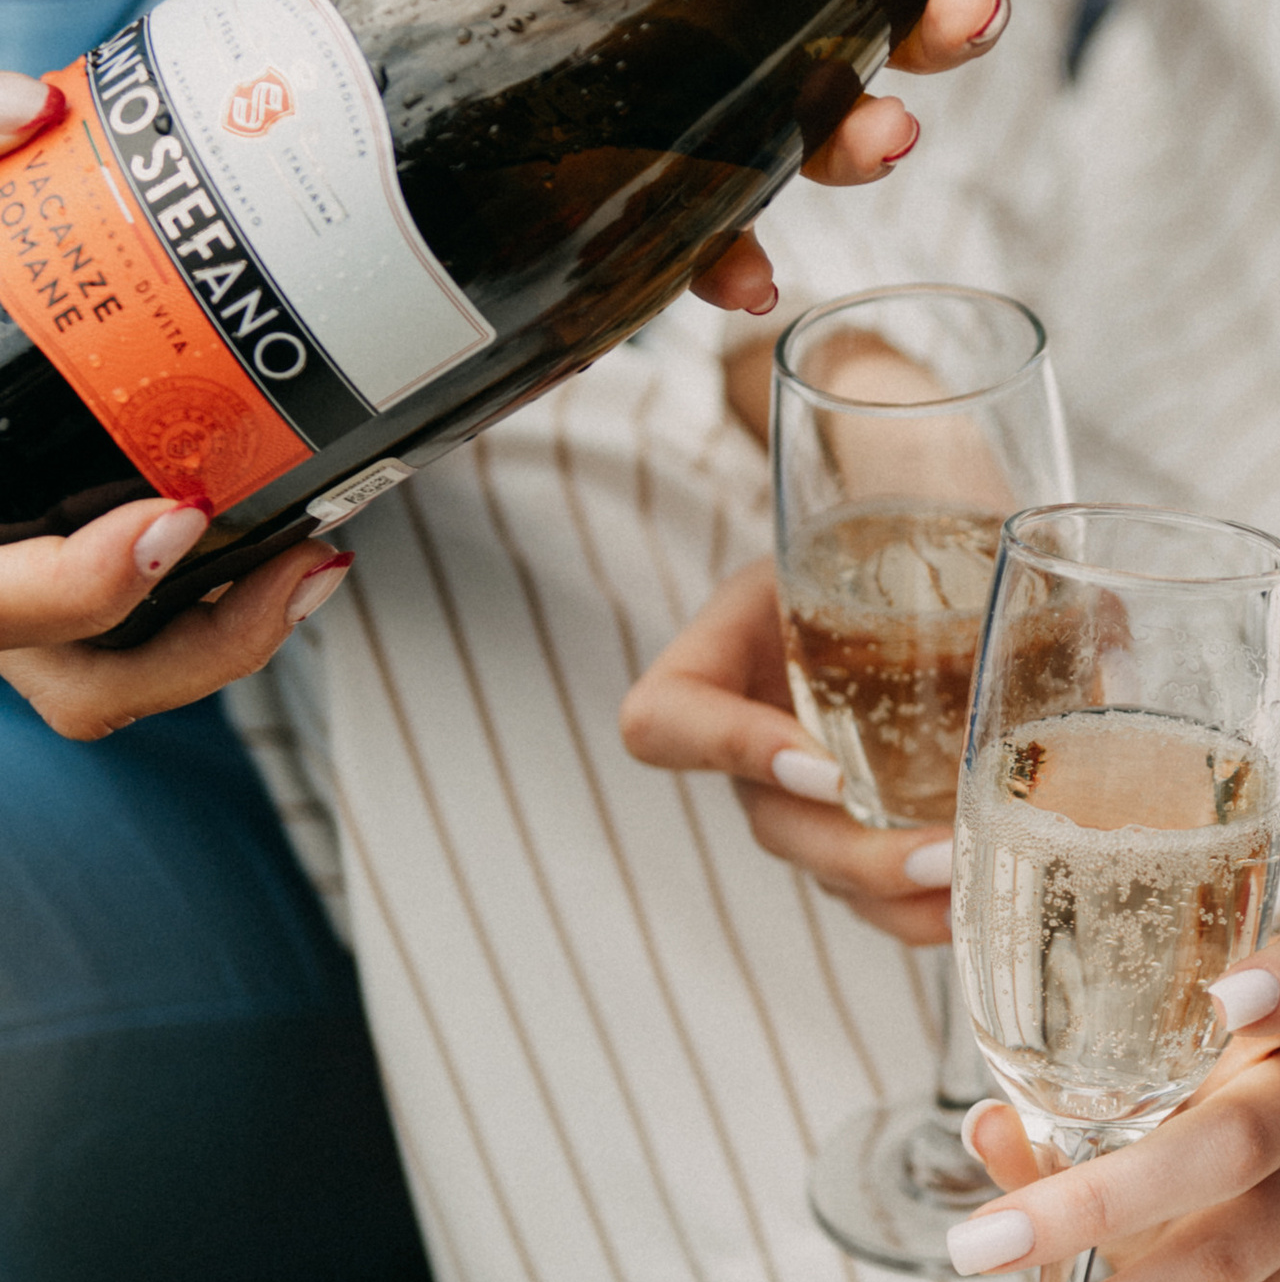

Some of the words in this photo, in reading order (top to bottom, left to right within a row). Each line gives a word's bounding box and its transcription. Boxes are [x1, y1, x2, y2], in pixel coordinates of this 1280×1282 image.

[25, 149, 123, 323] VACANZE
[284, 147, 333, 225] ITALIANA
[131, 134, 307, 380] STEFANO
[153, 305, 188, 354] VITA
